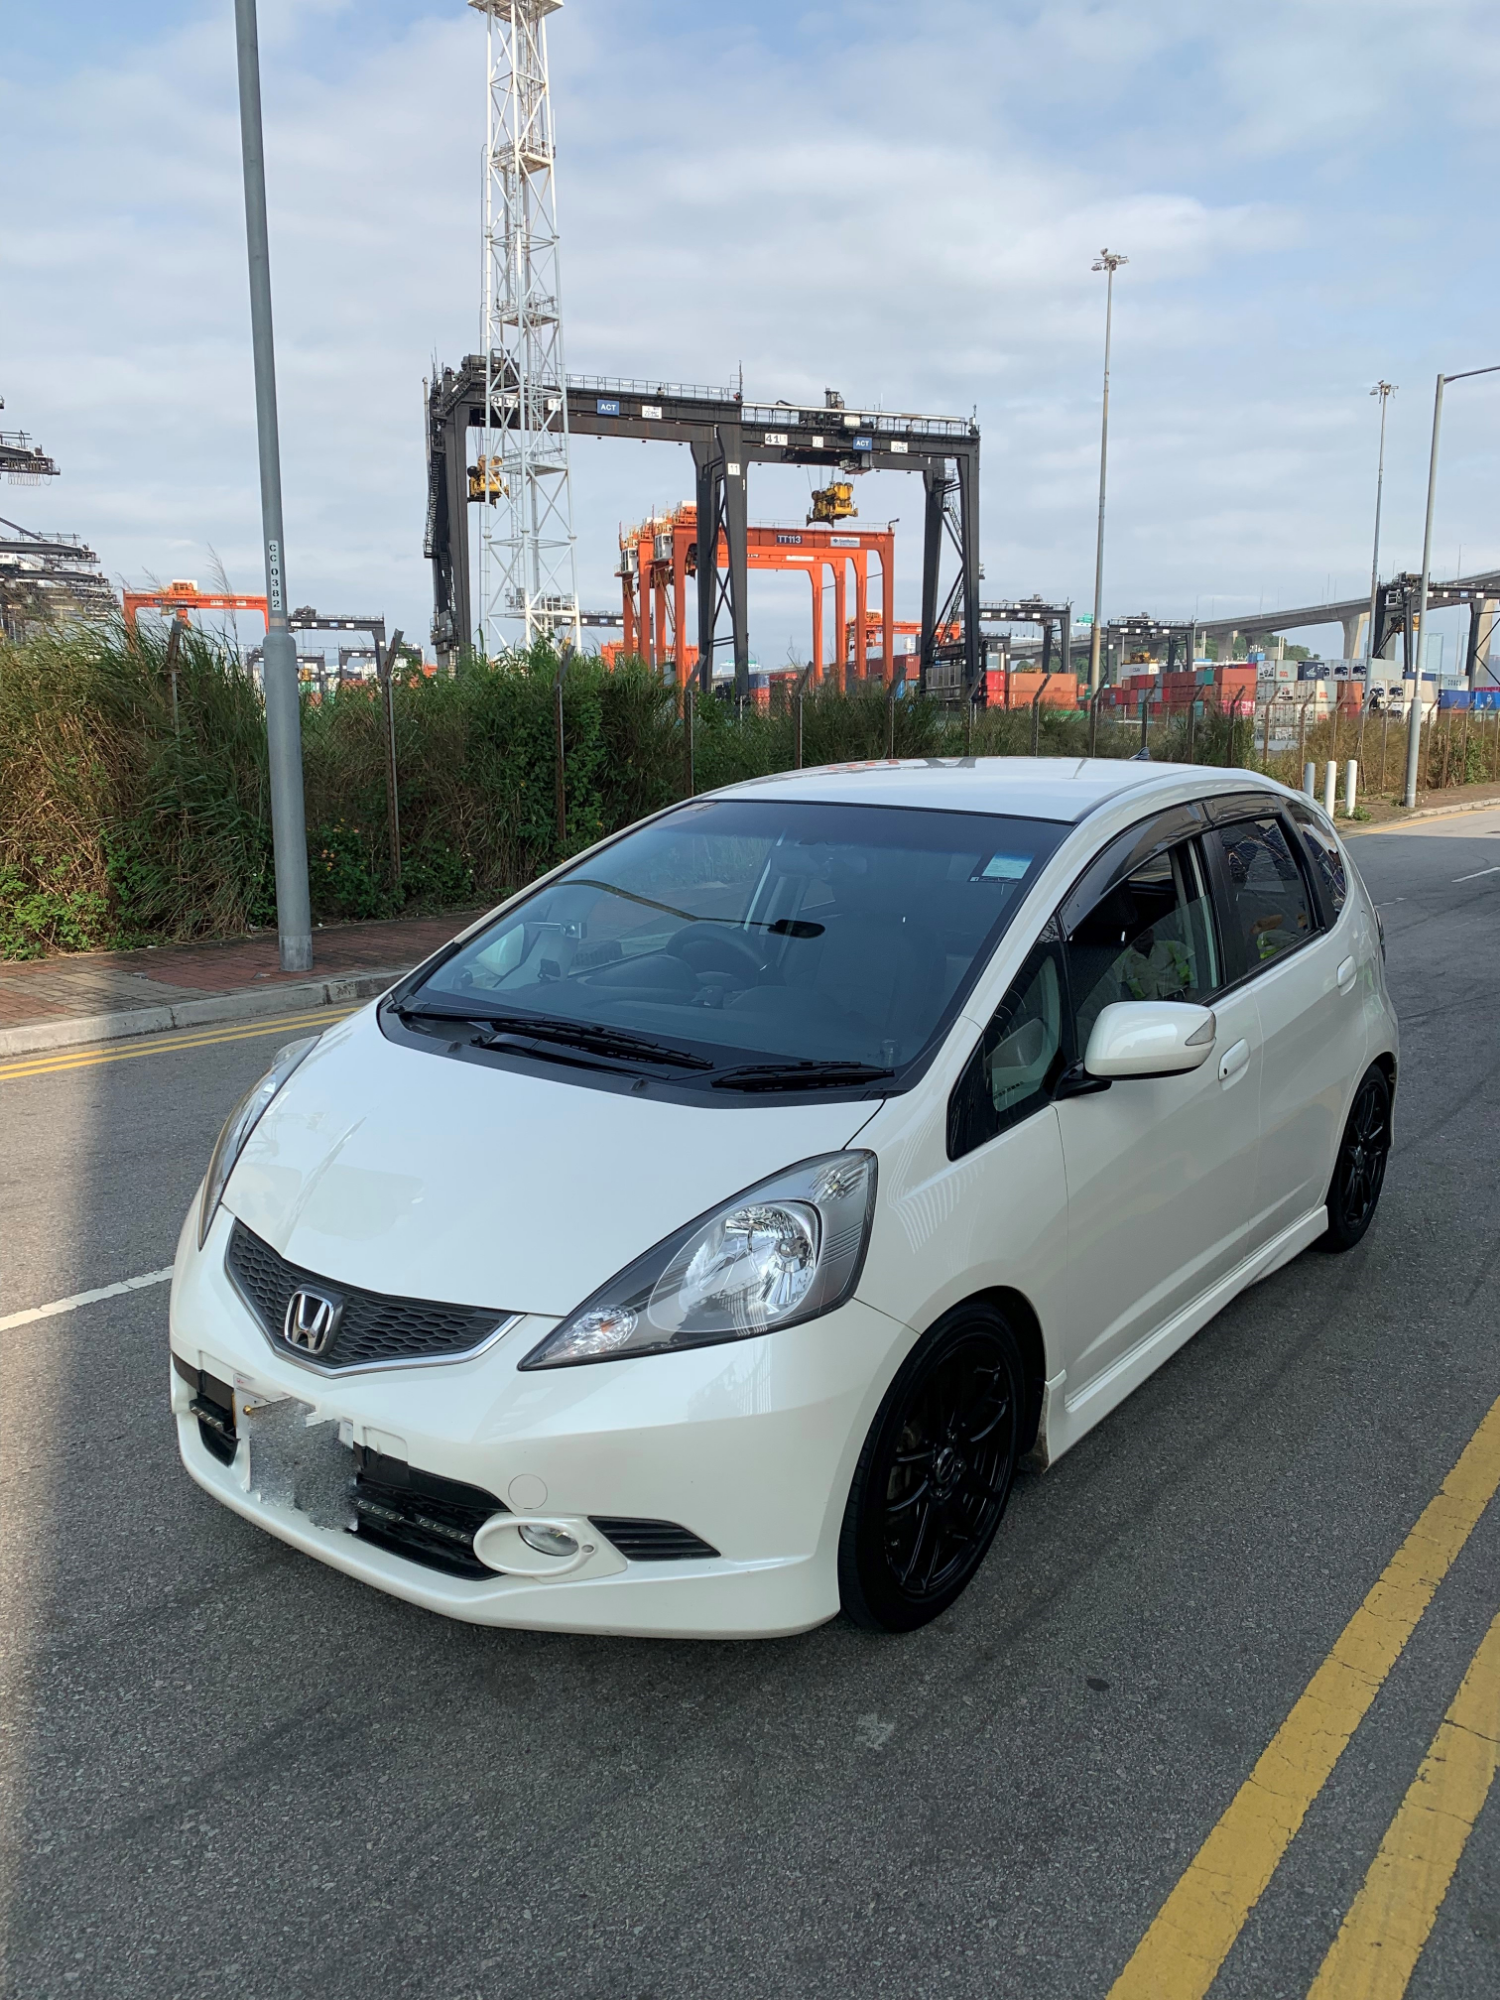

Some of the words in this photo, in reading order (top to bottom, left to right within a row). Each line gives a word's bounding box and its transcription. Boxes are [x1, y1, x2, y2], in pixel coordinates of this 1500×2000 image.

[600, 403, 617, 412] ACT
[855, 439, 870, 447] ACT
[777, 535, 801, 544] TT113
